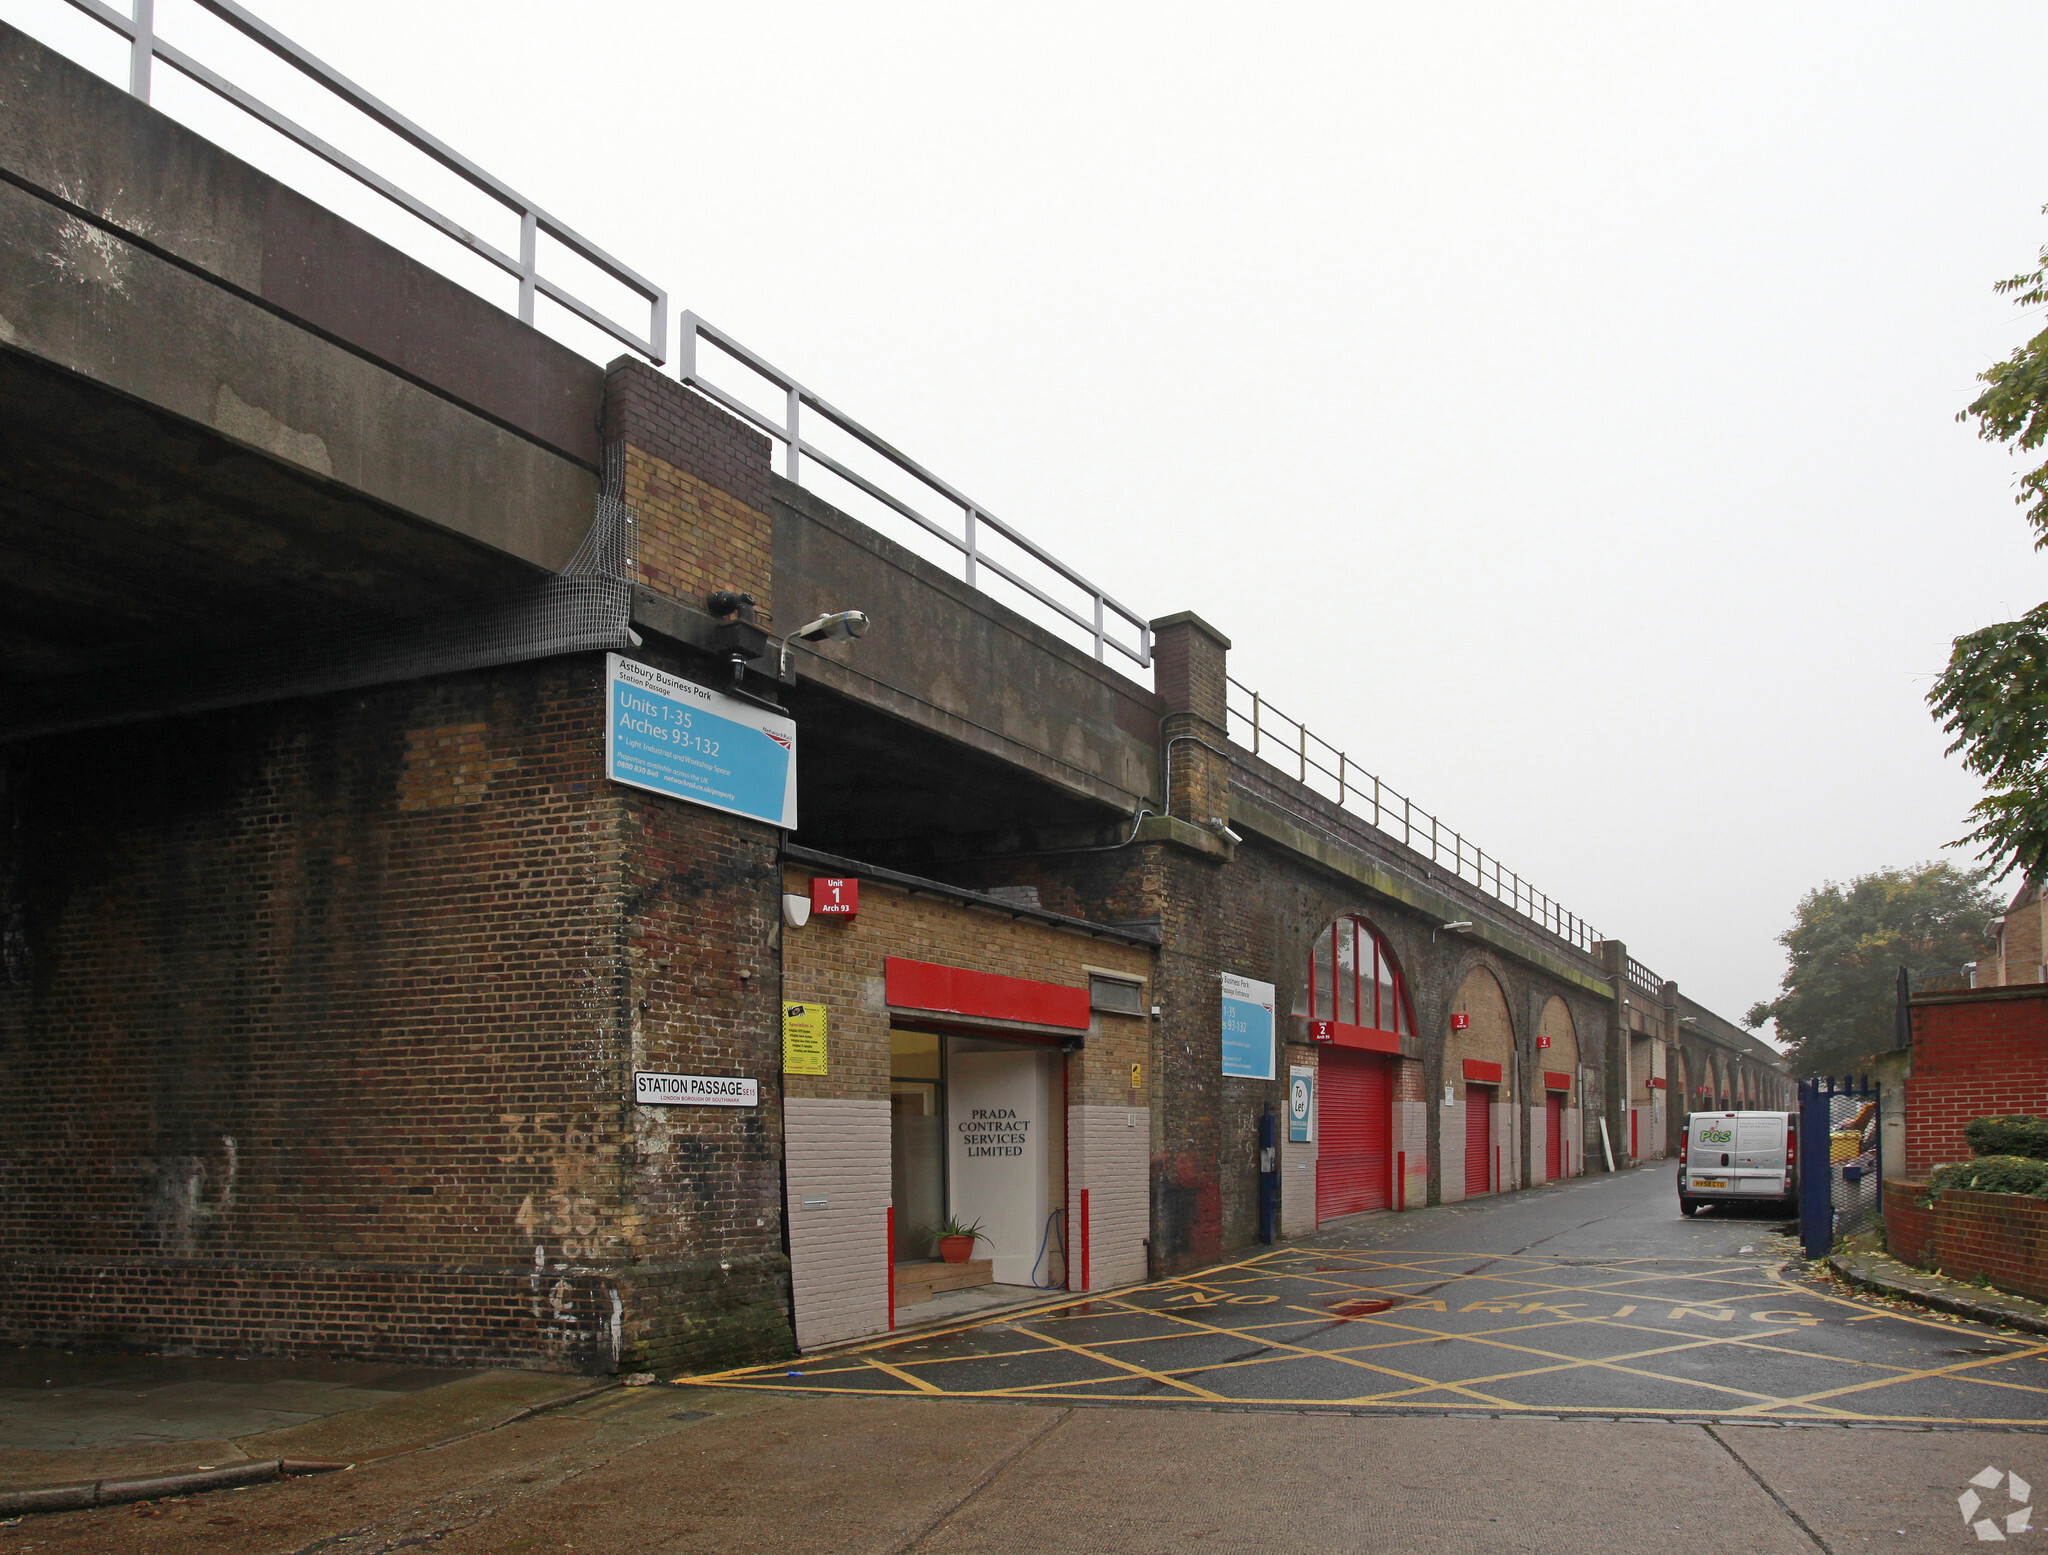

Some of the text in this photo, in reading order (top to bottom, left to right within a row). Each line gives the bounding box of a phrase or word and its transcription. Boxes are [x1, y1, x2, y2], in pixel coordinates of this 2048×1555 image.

[619, 671, 671, 696] Station Passage
[620, 660, 712, 701] Astbury Business Park
[620, 691, 692, 728] Units 1-35
[620, 712, 720, 757] Arches 93-132
[625, 737, 732, 776] Light Industrial and Workshop Space
[616, 751, 709, 785] Properties available across the UK
[616, 760, 736, 801] 0800 830 840 networkrail.co.uk/property
[827, 879, 843, 887] Unit
[832, 887, 840, 903] 1
[822, 904, 850, 912] Arch 93
[1224, 976, 1250, 988] Business Park
[1223, 1006, 1236, 1018] 1-35
[1228, 1019, 1247, 1033] 93-132
[1320, 1026, 1326, 1035] 2
[638, 1077, 756, 1097] STATION PASSAGE SE15
[1295, 1085, 1302, 1098] To
[1295, 1100, 1304, 1112] Let
[972, 1109, 1017, 1120] PRADA
[958, 1121, 1030, 1132] CONTRACT
[964, 1133, 1026, 1145] SERVICES
[1700, 1130, 1731, 1142] PCS
[968, 1146, 1023, 1157] LIMITED
[1163, 1292, 1825, 1326] NO PARKING
